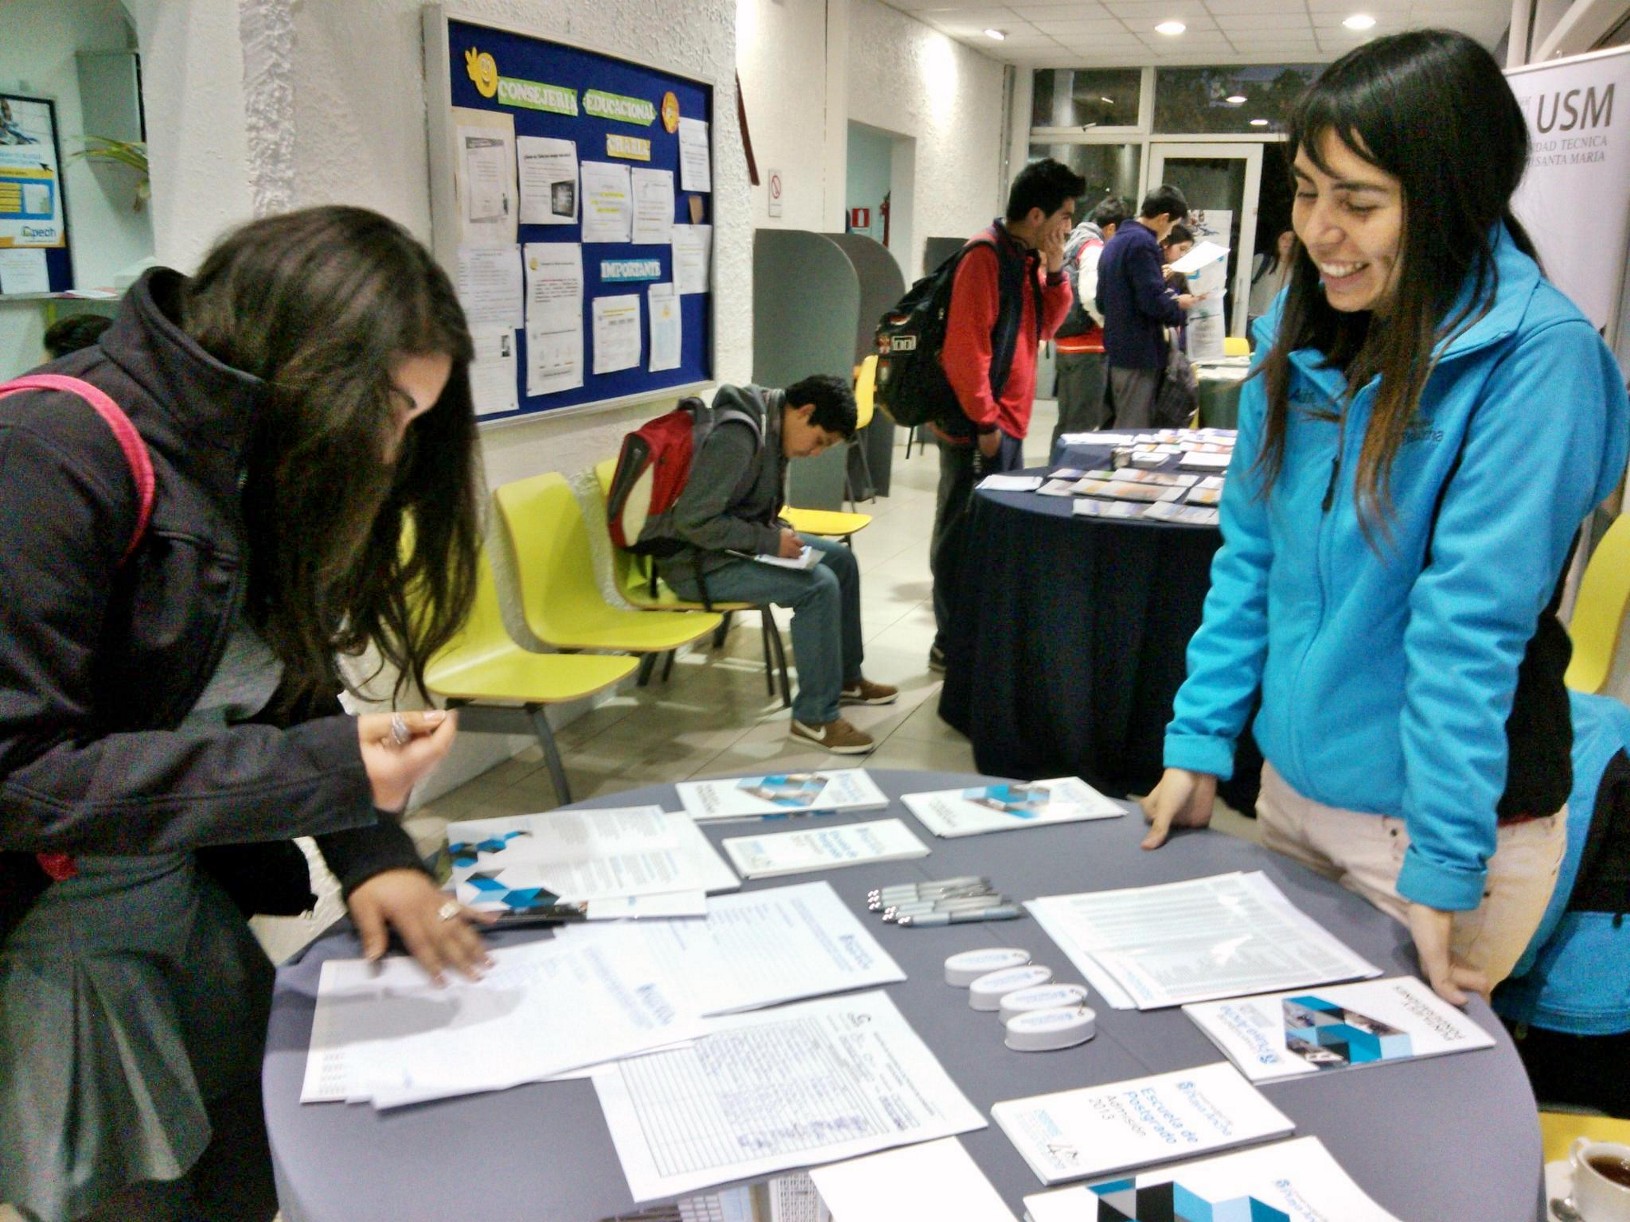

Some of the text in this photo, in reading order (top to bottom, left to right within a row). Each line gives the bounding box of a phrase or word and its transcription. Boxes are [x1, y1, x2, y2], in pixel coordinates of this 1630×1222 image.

[1537, 83, 1615, 133] USM
[601, 261, 661, 279] IMPORTANTE
[1122, 1091, 1177, 1144] Postgrado
[1141, 1087, 1199, 1142] Escuela de
